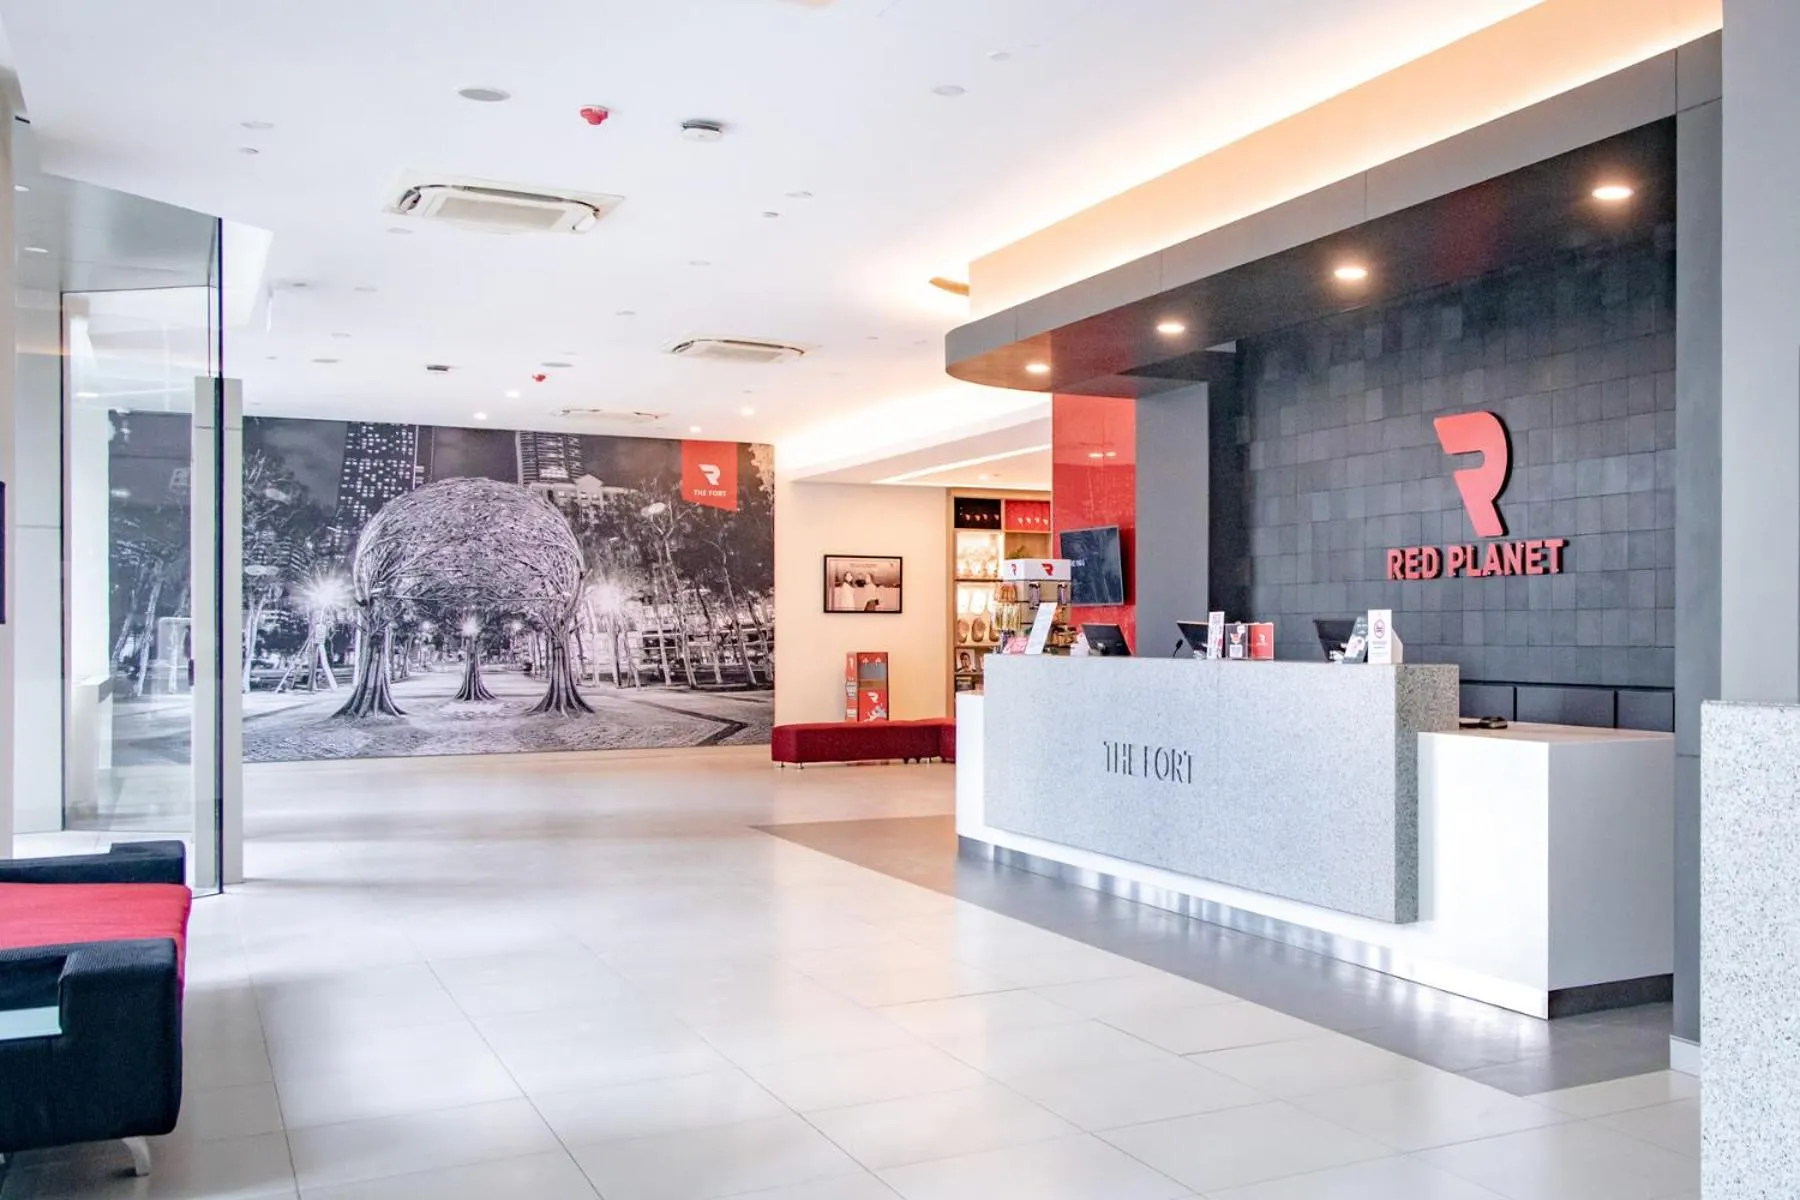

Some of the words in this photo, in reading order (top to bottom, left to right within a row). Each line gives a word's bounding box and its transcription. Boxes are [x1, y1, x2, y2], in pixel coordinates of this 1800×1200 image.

[693, 489, 706, 497] THE
[1387, 547, 1440, 580] RED
[1447, 538, 1566, 577] PLANET
[1103, 741, 1136, 776] THE
